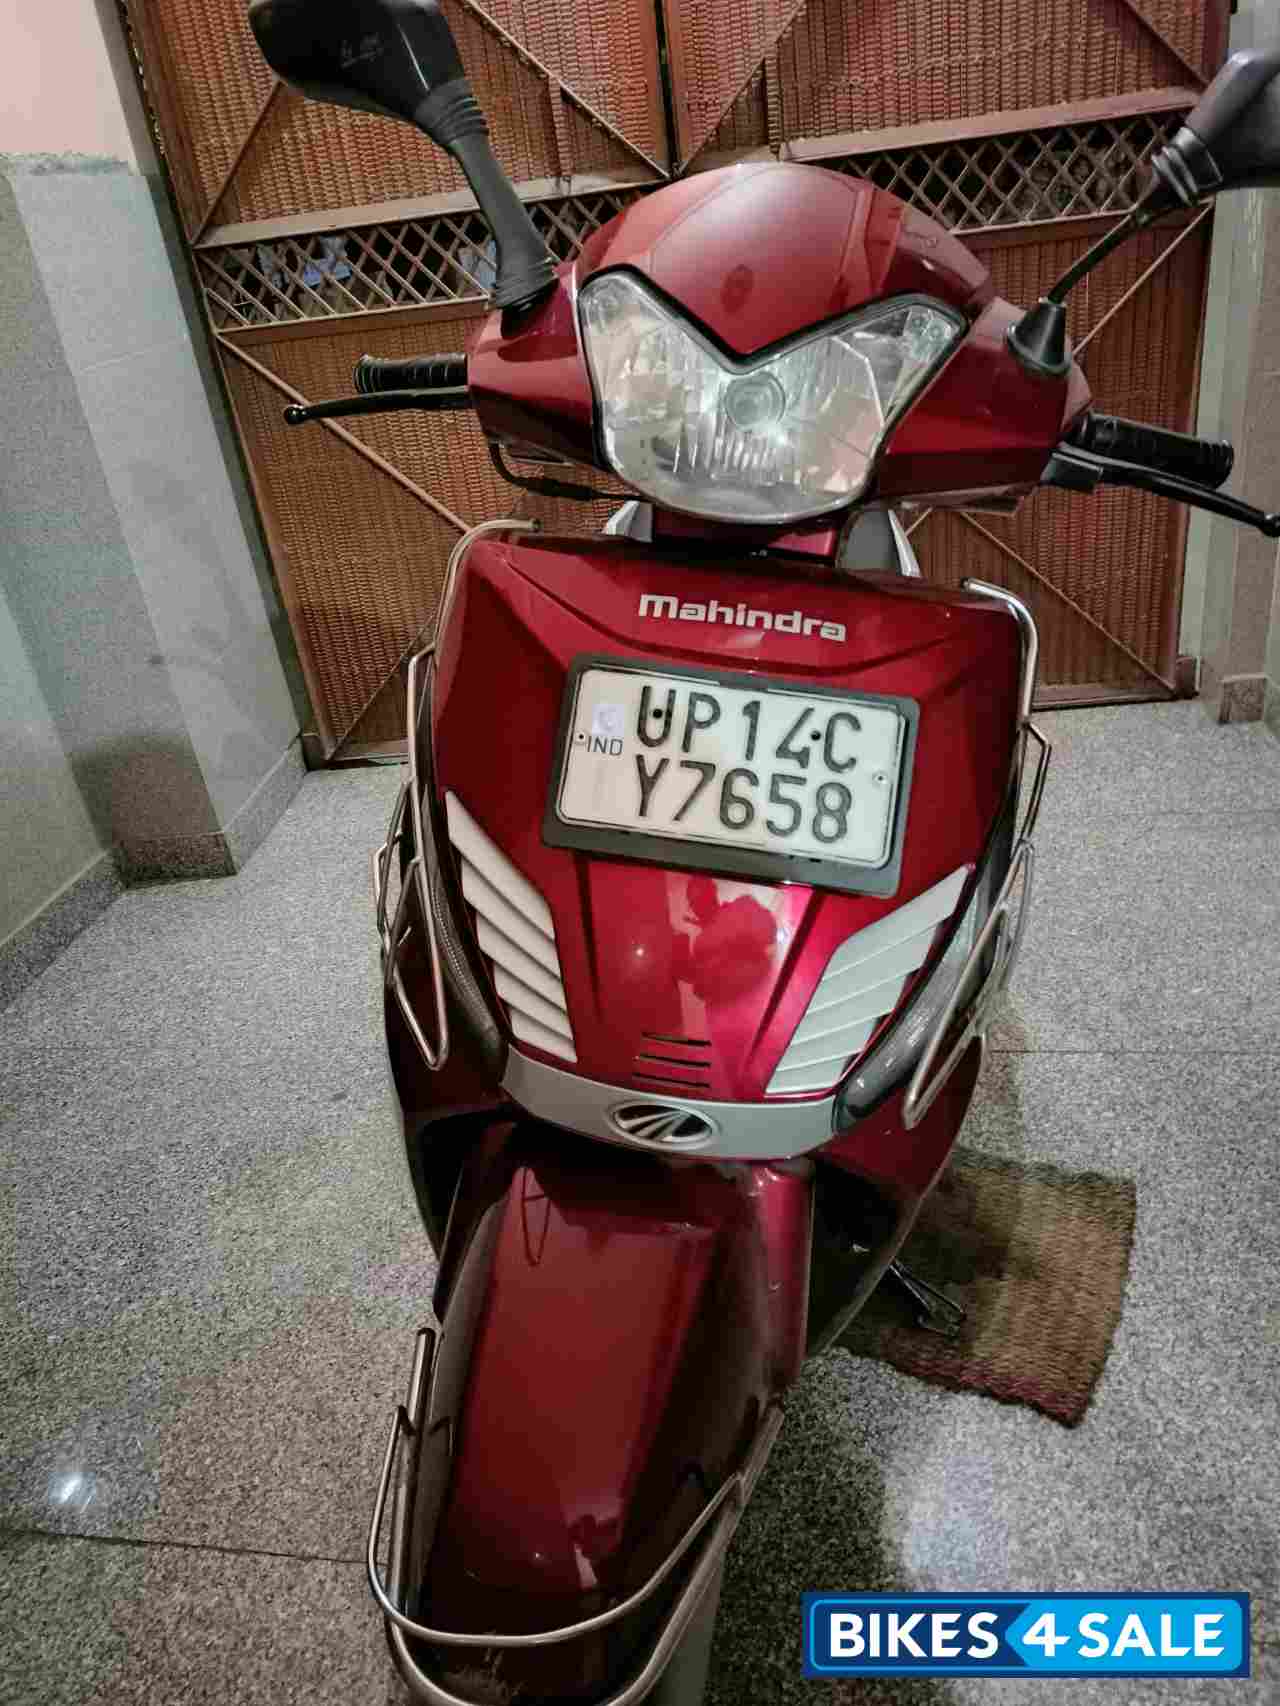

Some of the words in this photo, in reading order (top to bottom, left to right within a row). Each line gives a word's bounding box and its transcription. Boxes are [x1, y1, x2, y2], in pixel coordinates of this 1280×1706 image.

[638, 594, 847, 643] Mahindra
[587, 735, 624, 756] IND
[635, 753, 853, 844] Y7658
